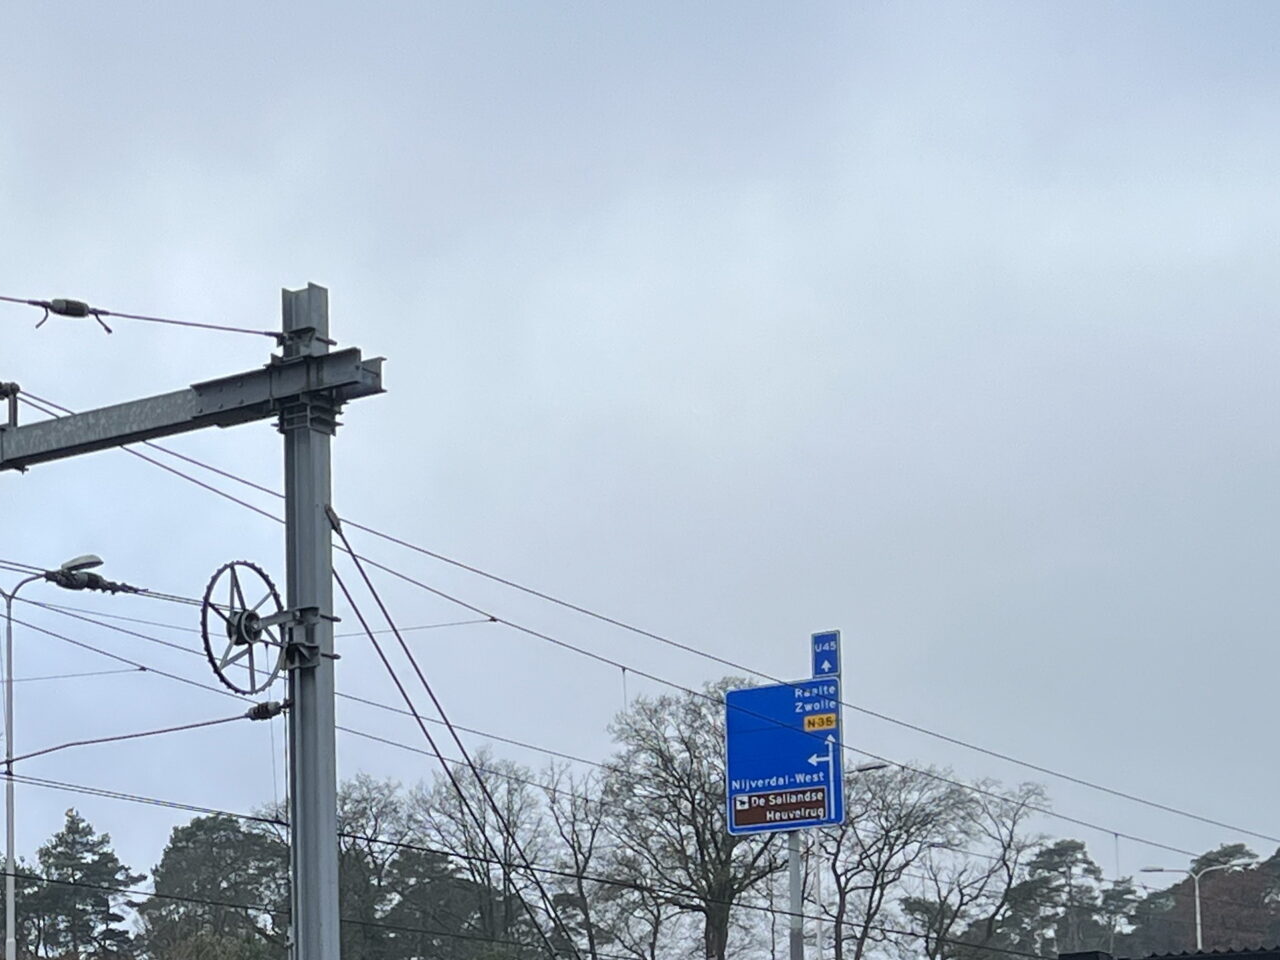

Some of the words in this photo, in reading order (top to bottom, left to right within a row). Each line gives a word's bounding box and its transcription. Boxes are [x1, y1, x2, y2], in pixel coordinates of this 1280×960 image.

[794, 684, 836, 699] Raalte
[794, 700, 837, 713] Zwolle
[732, 771, 825, 791] Nijverdal-West
[751, 796, 766, 807] De
[768, 790, 824, 806] Sallandse
[766, 807, 825, 822] Heuvelrug
